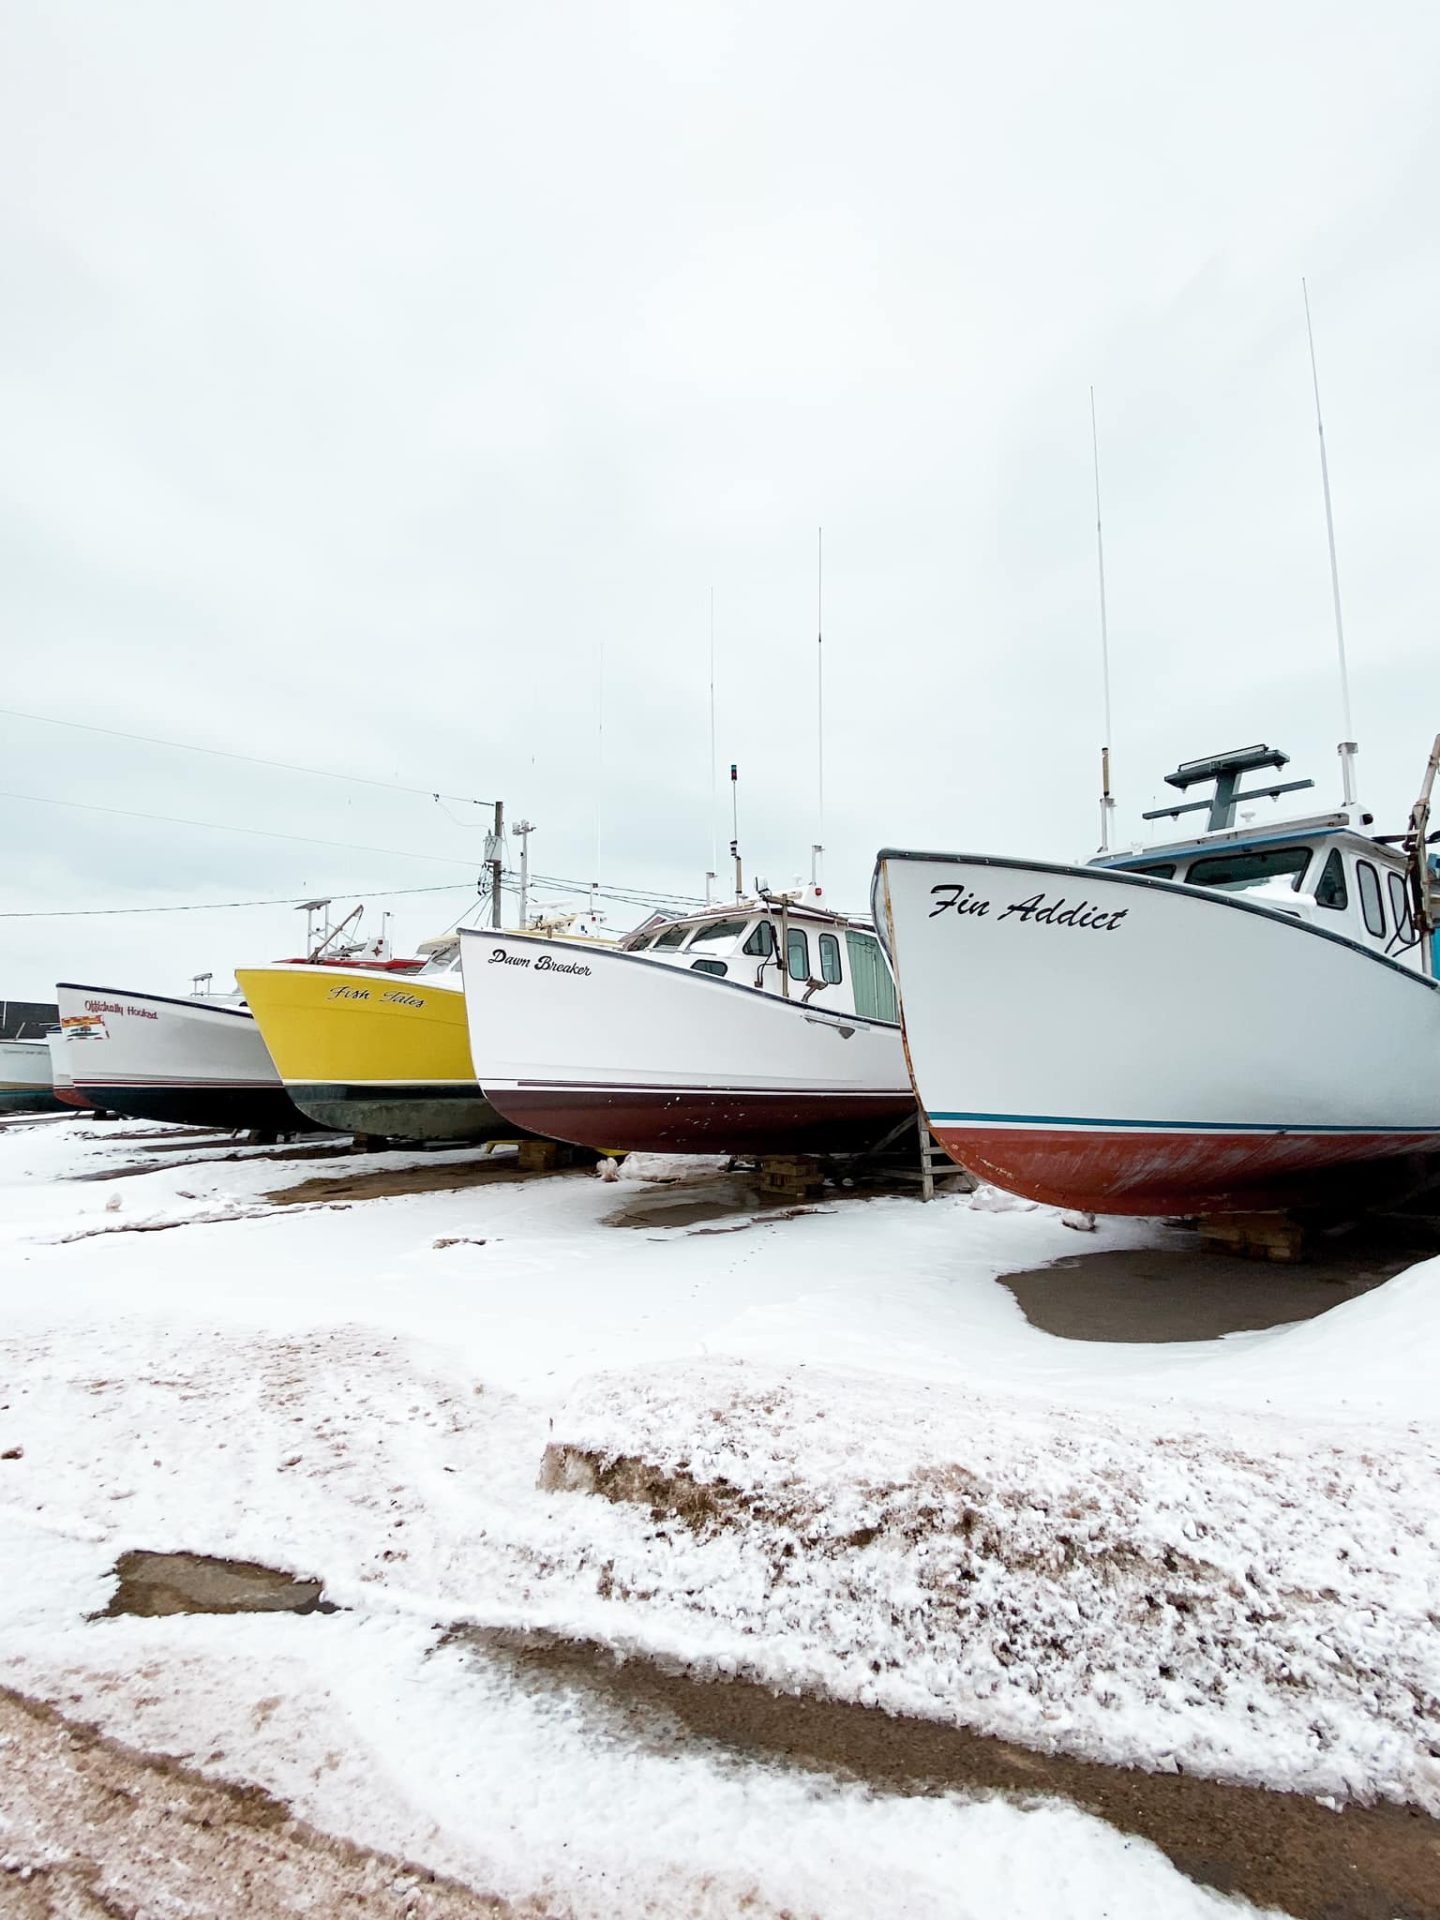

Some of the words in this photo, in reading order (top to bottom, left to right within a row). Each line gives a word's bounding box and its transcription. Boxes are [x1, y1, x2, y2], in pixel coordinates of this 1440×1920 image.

[929, 884, 990, 918] Fin
[997, 893, 1129, 931] Addict
[488, 949, 531, 968] Dawn
[534, 955, 592, 976] Breaker
[327, 986, 370, 1000] Fish
[379, 991, 425, 1008] Tales
